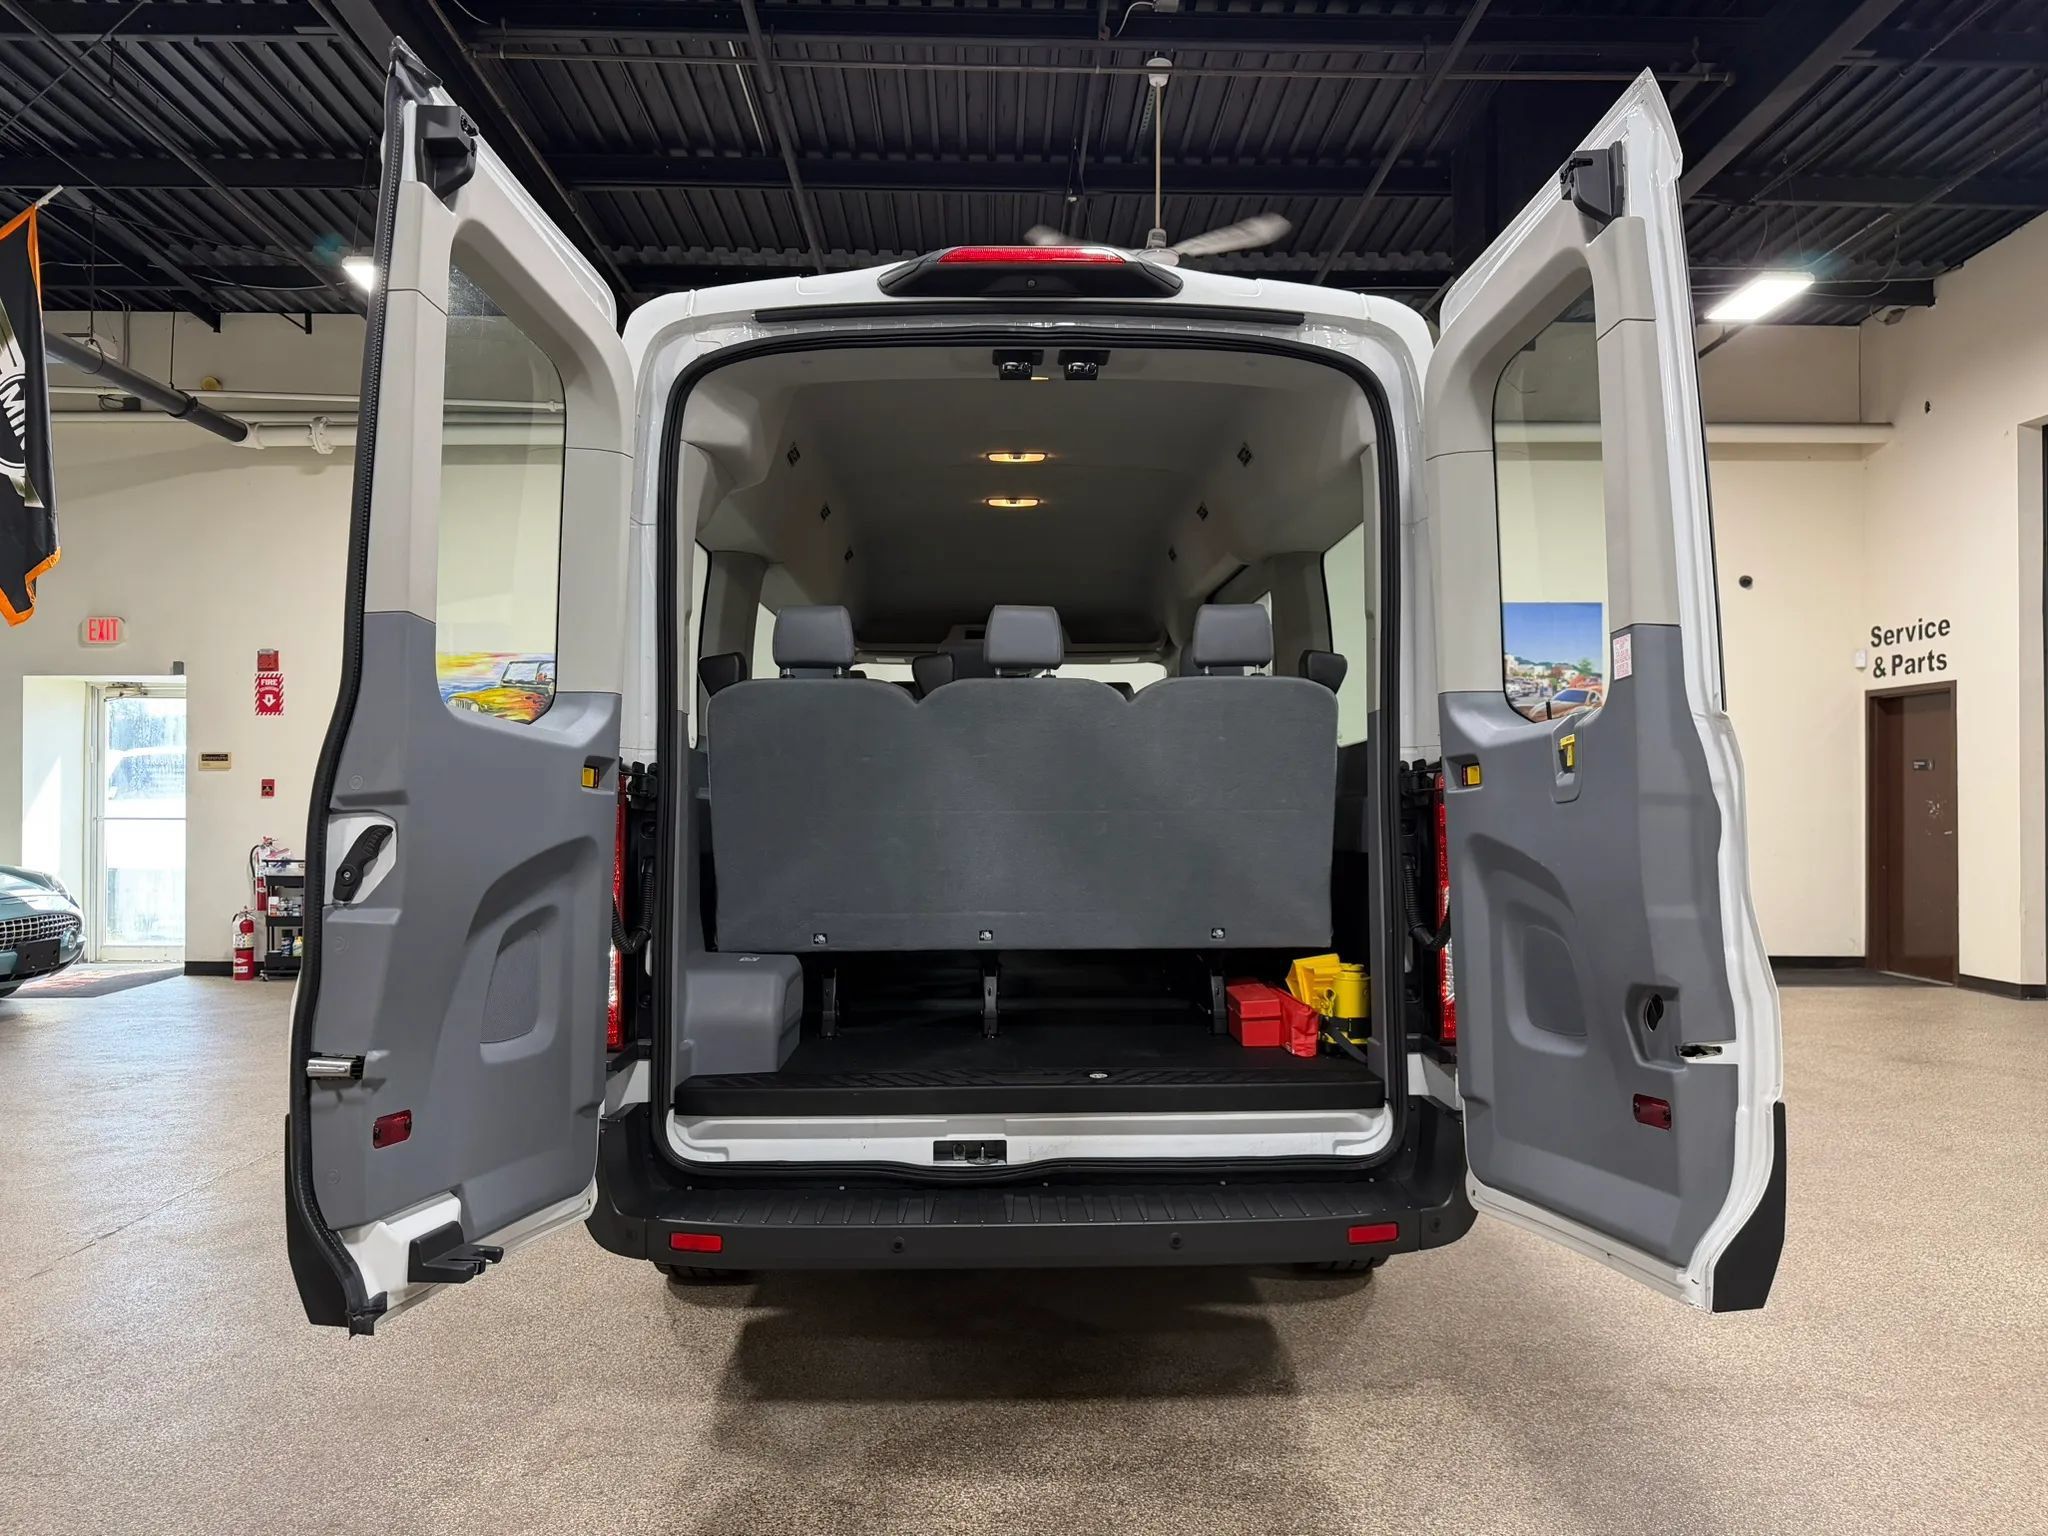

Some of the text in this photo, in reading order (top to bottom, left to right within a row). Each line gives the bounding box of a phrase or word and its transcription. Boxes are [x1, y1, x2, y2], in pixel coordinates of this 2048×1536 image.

[89, 618, 118, 641] EXIT
[1870, 617, 1951, 648] Service
[1872, 649, 1948, 679] & Parts
[260, 678, 278, 686] FIRE
